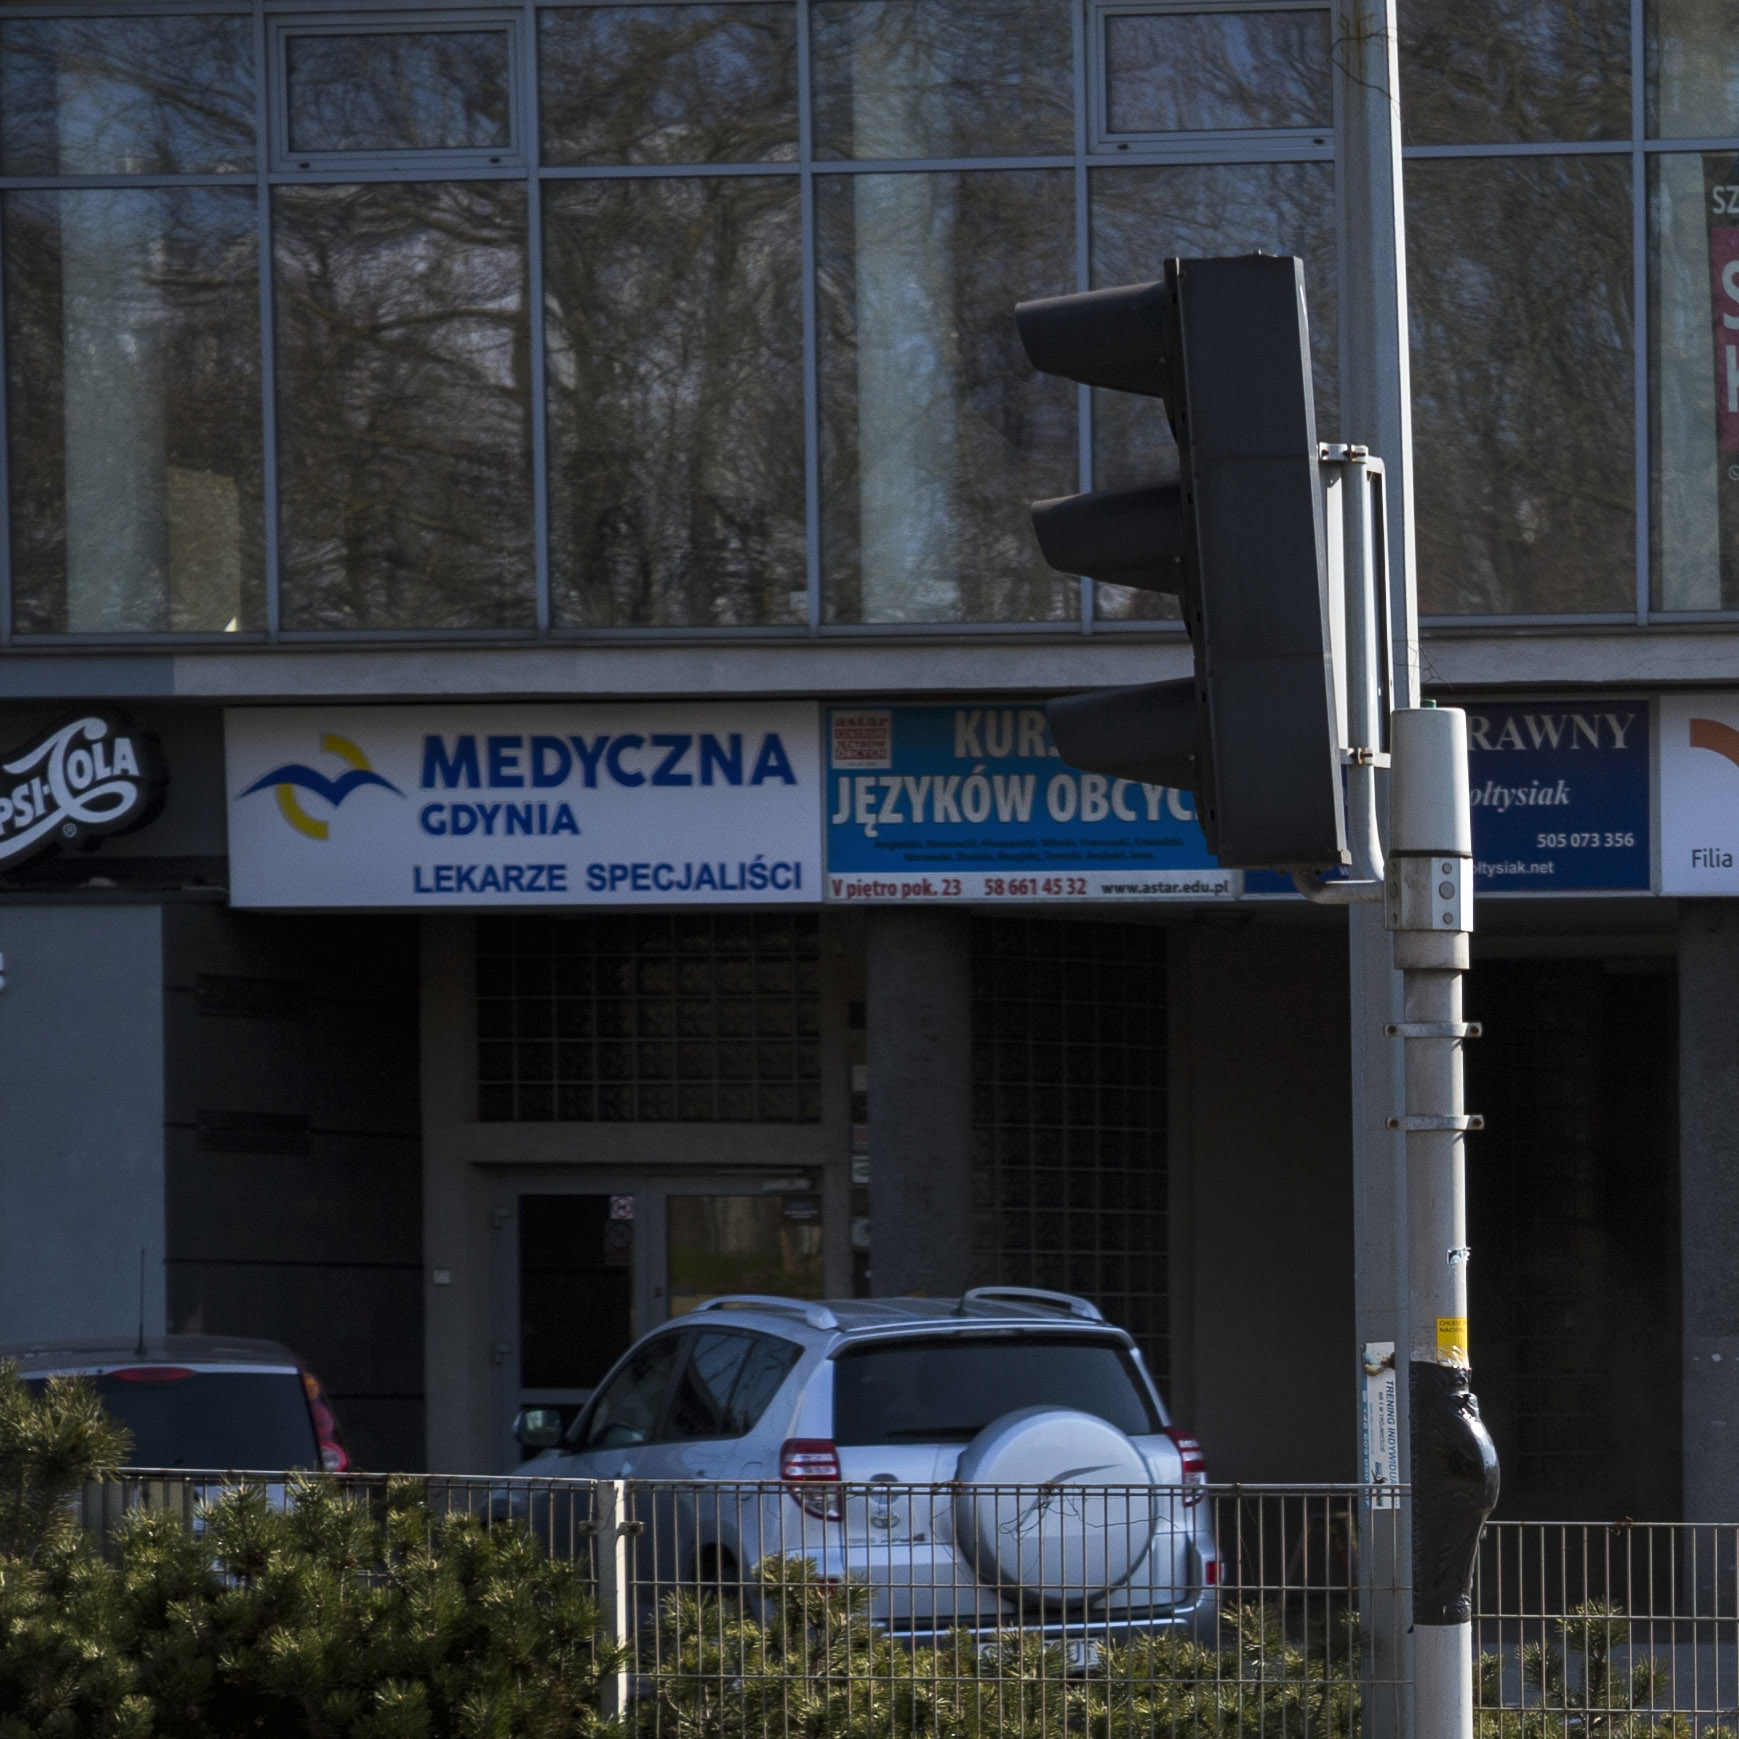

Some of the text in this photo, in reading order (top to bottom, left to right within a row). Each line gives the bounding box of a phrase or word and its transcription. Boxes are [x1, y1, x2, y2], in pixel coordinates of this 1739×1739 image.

[954, 710, 1062, 758] KUR
[421, 733, 797, 789] MEDYCZNA
[832, 765, 1037, 838] JĘZYKÓW
[421, 803, 581, 837] GDYNIA
[1536, 832, 1635, 848] 505 073 356
[413, 854, 802, 896] LEKARZE SPECJALIŚCI
[1691, 848, 1732, 870] Filia
[832, 878, 962, 899] V piętro pok. 23
[984, 879, 1087, 896] 58 661 45 32
[1101, 879, 1229, 898] www.astar.edu.pl
[1386, 1380, 1396, 1425] TRENING
